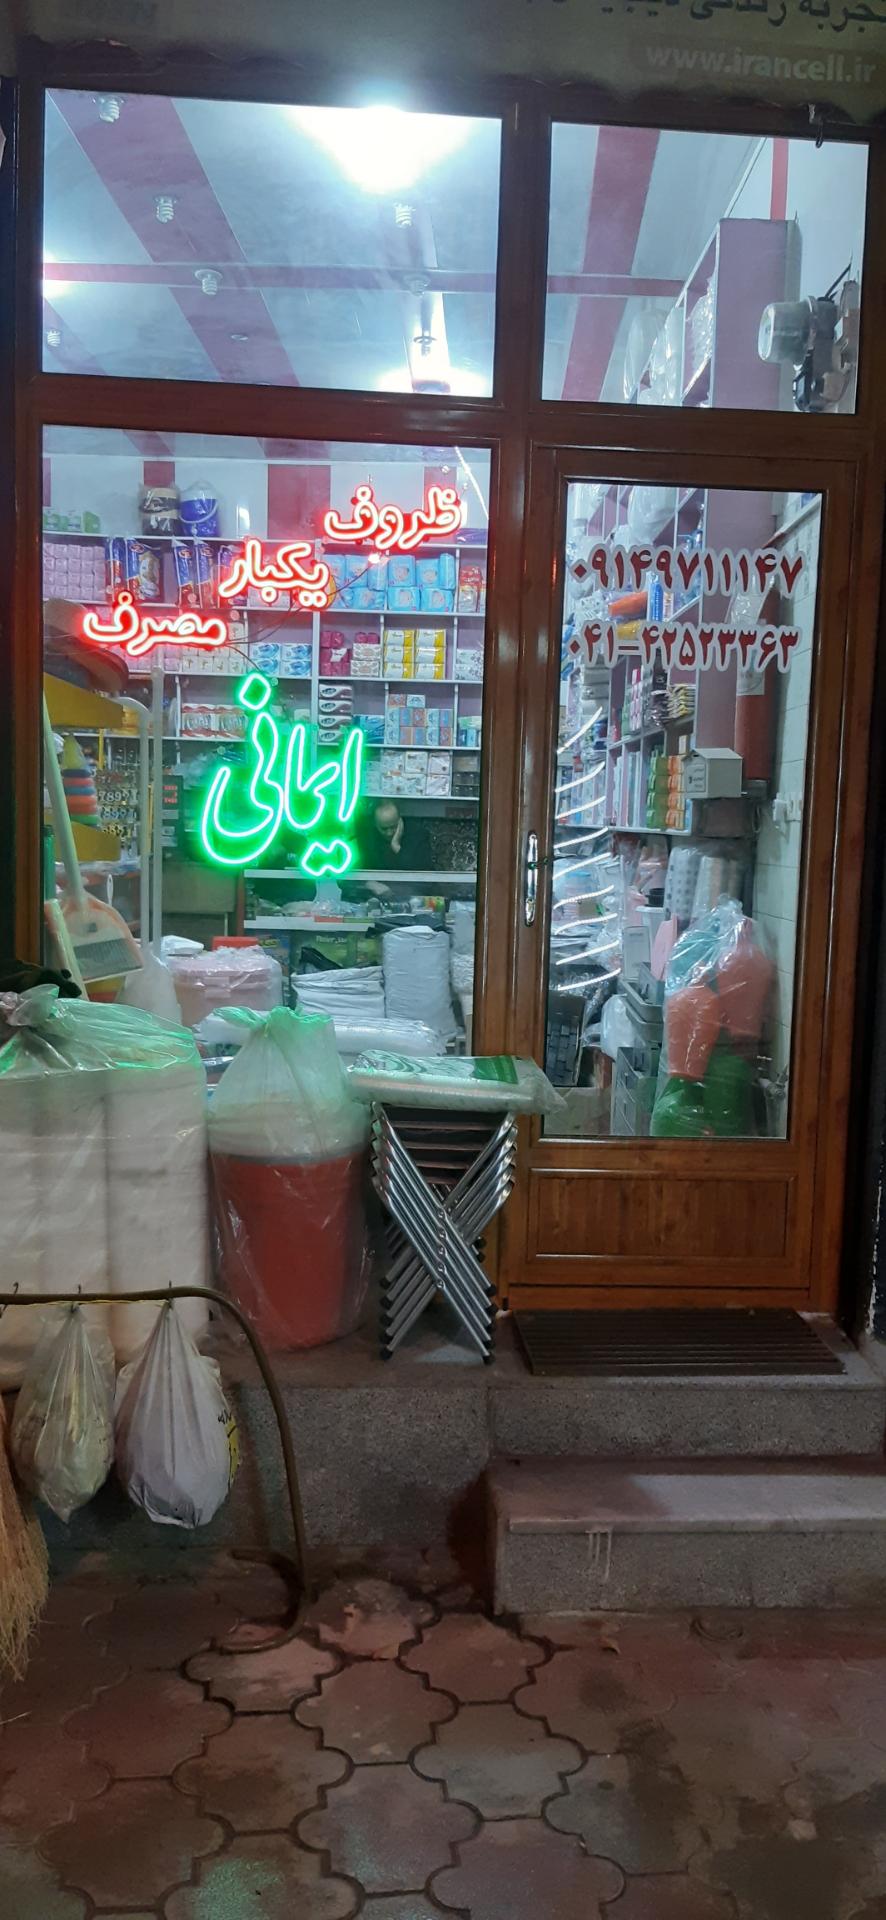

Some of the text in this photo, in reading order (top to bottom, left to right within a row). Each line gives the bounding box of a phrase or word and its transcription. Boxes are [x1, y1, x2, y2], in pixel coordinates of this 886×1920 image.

[645, 45, 877, 82] www.irancell.ir
[83, 484, 464, 656] ظروف یکبار مصرف
[572, 547, 806, 596] ۰۹۱۴۹۷۱۱۱۴۷
[200, 672, 364, 877] ایمانی
